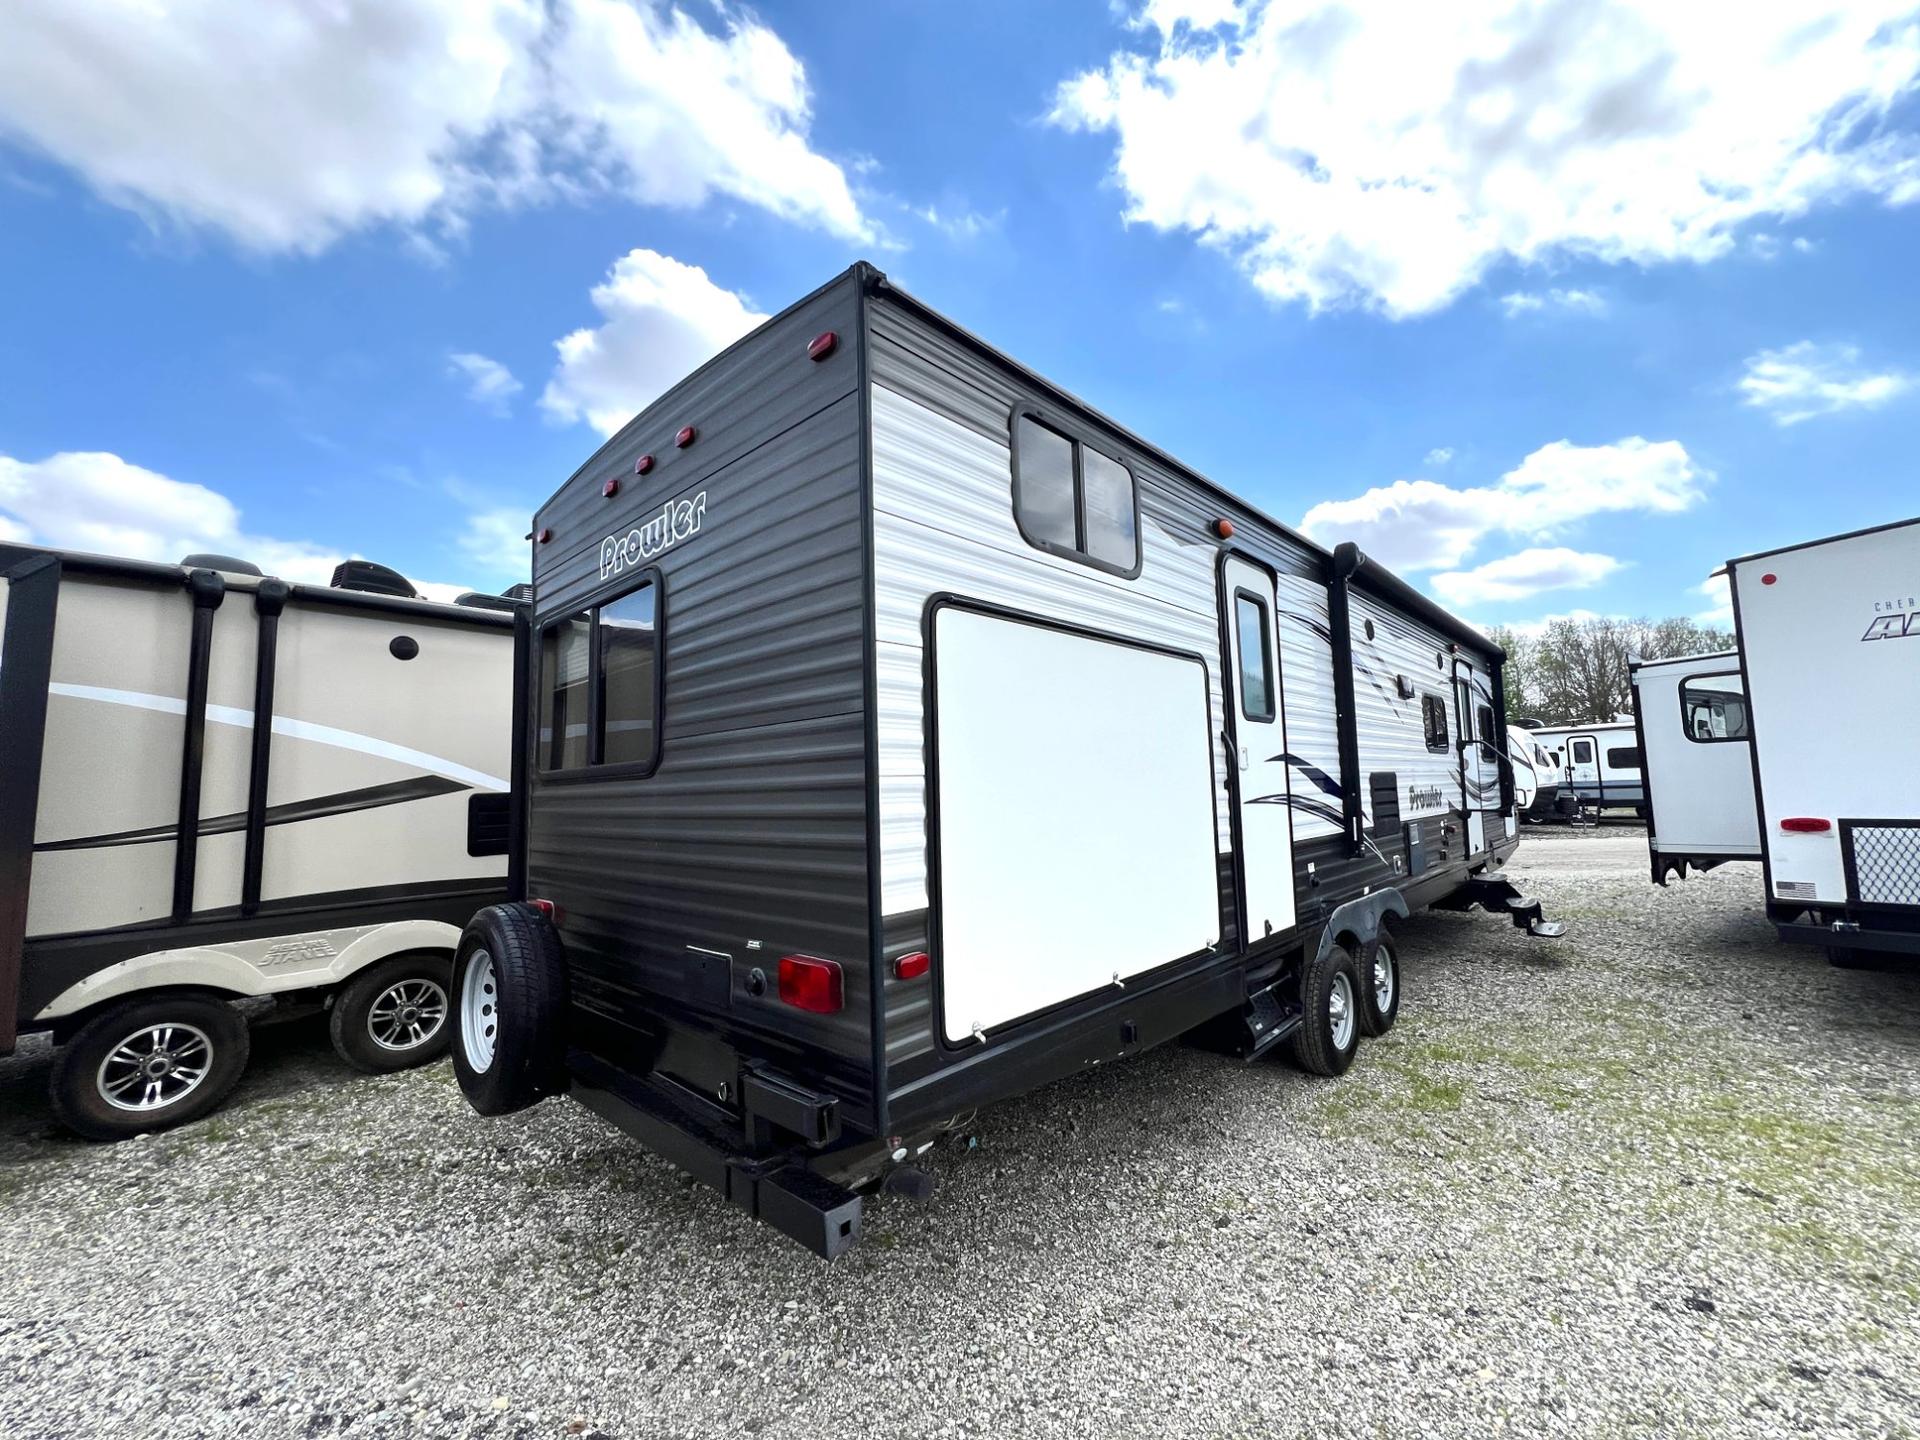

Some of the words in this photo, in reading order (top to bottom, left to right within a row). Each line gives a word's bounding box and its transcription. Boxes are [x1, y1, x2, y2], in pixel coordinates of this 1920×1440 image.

[600, 491, 707, 581] Prowler
[1874, 597, 1915, 612] CHER
[1408, 784, 1443, 812] Prowler
